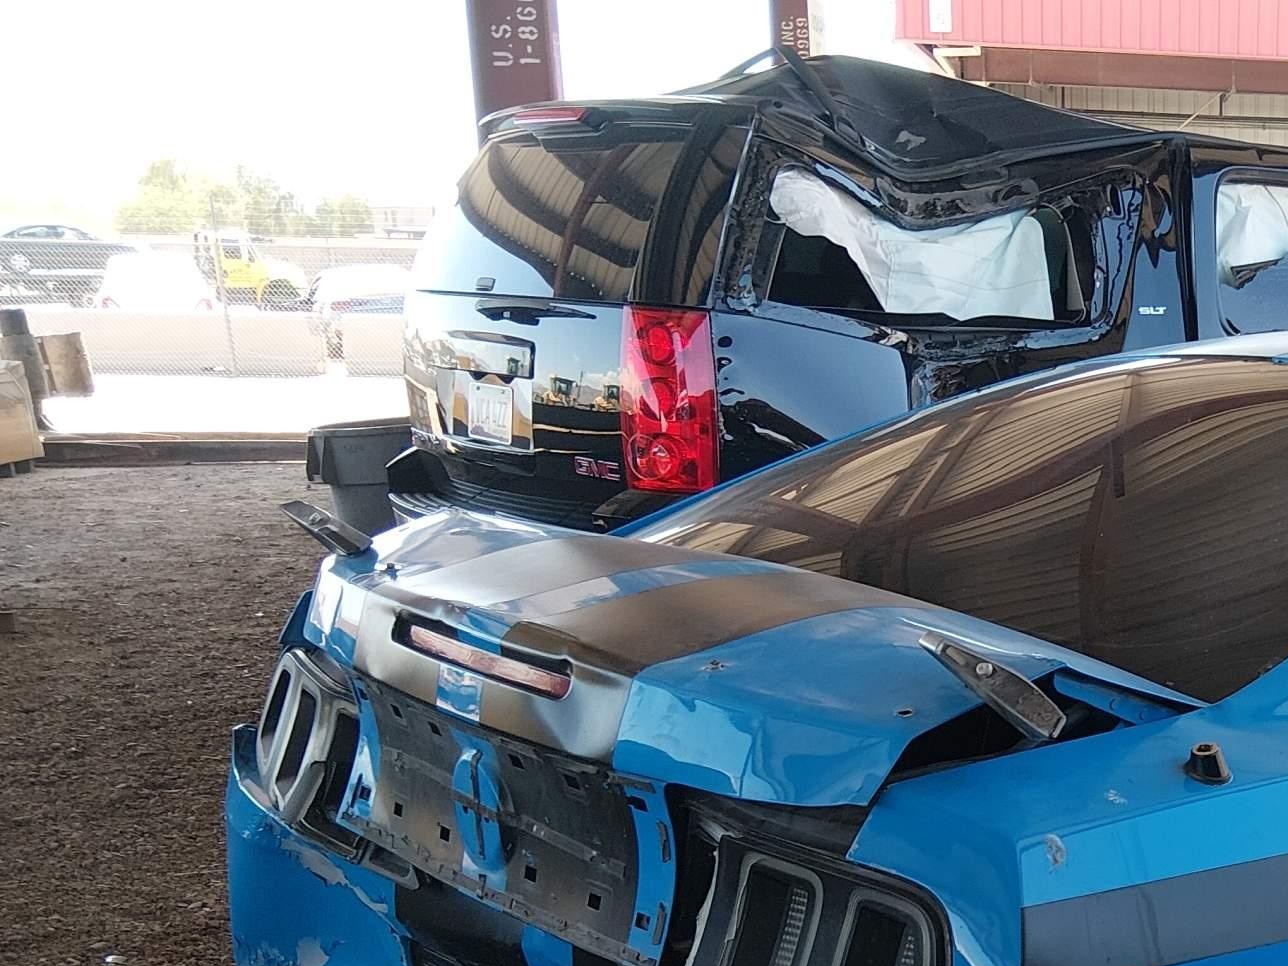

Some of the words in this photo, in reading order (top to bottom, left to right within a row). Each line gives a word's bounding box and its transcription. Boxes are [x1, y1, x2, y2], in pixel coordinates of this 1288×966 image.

[490, 16, 514, 66] U.S.
[516, 0, 541, 64] 1-86
[781, 16, 795, 46] INC.
[1138, 306, 1167, 315] SLT
[574, 455, 621, 481] GMC
